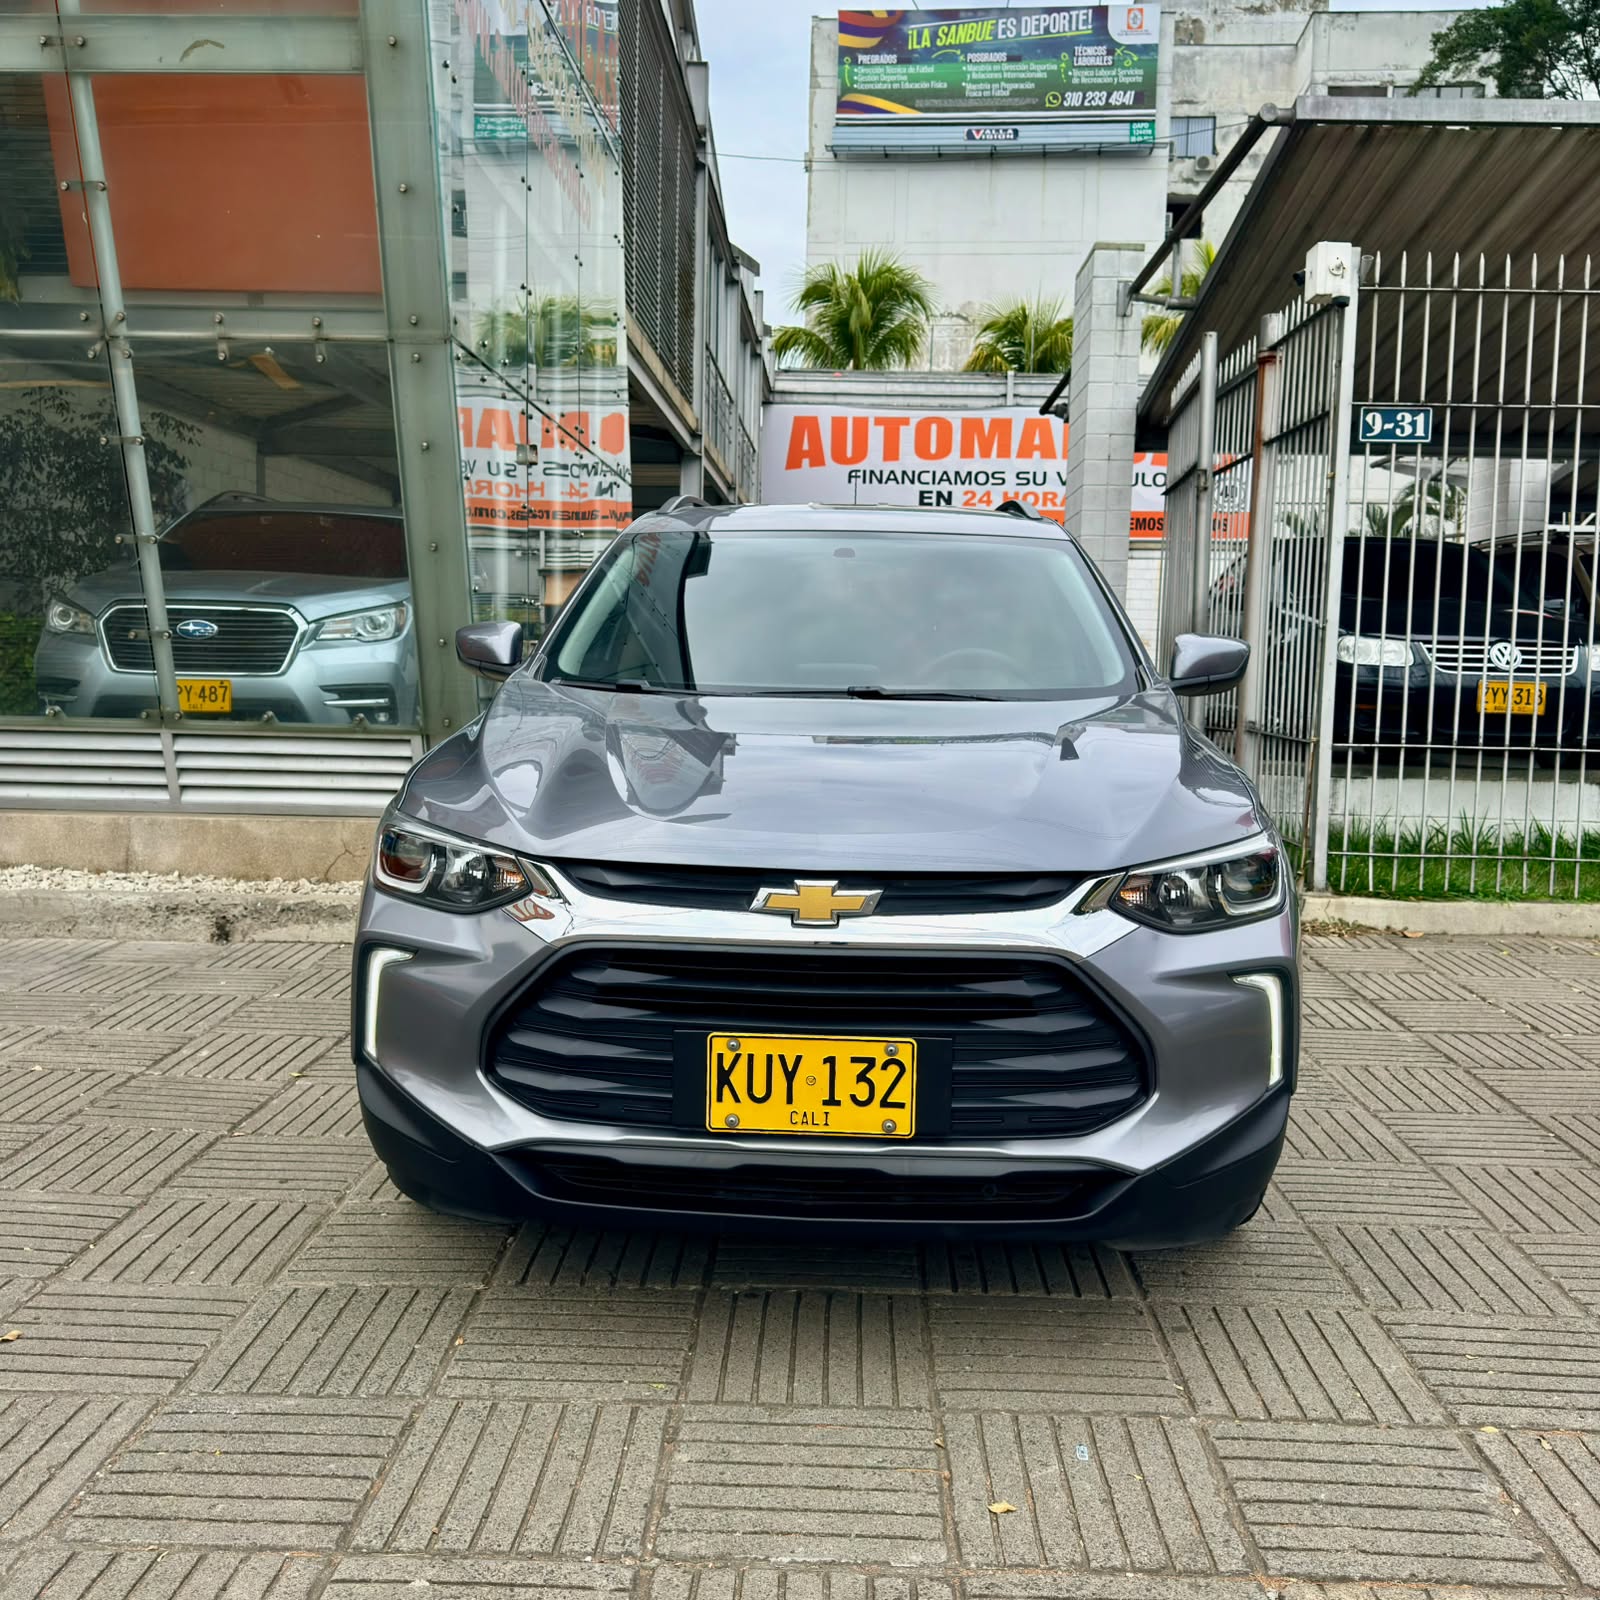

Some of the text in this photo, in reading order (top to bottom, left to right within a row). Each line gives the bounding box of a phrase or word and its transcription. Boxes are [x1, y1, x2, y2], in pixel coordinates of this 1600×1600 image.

[936, 20, 996, 46] SANBUE
[998, 18, 1016, 39] ES
[1021, 9, 1092, 37] DEPORTE!
[967, 52, 1007, 62] POSGRADOS
[1074, 44, 1107, 56] TÉCNICOS
[858, 54, 897, 64] PREGRADOS
[1074, 56, 1112, 66] LABORALES
[1064, 90, 1135, 106] 310 233 4941
[1365, 412, 1425, 436] 9-31
[785, 416, 1067, 470] AUTOMA
[848, 470, 1006, 486] FINANCIAMOS
[1016, 471, 1047, 486] SU
[919, 491, 952, 506] EN
[962, 491, 992, 508] 24
[1130, 518, 1164, 530] EMOS
[198, 685, 228, 702] 487
[716, 1053, 906, 1109] KUY 132
[790, 1110, 830, 1126] CALI
